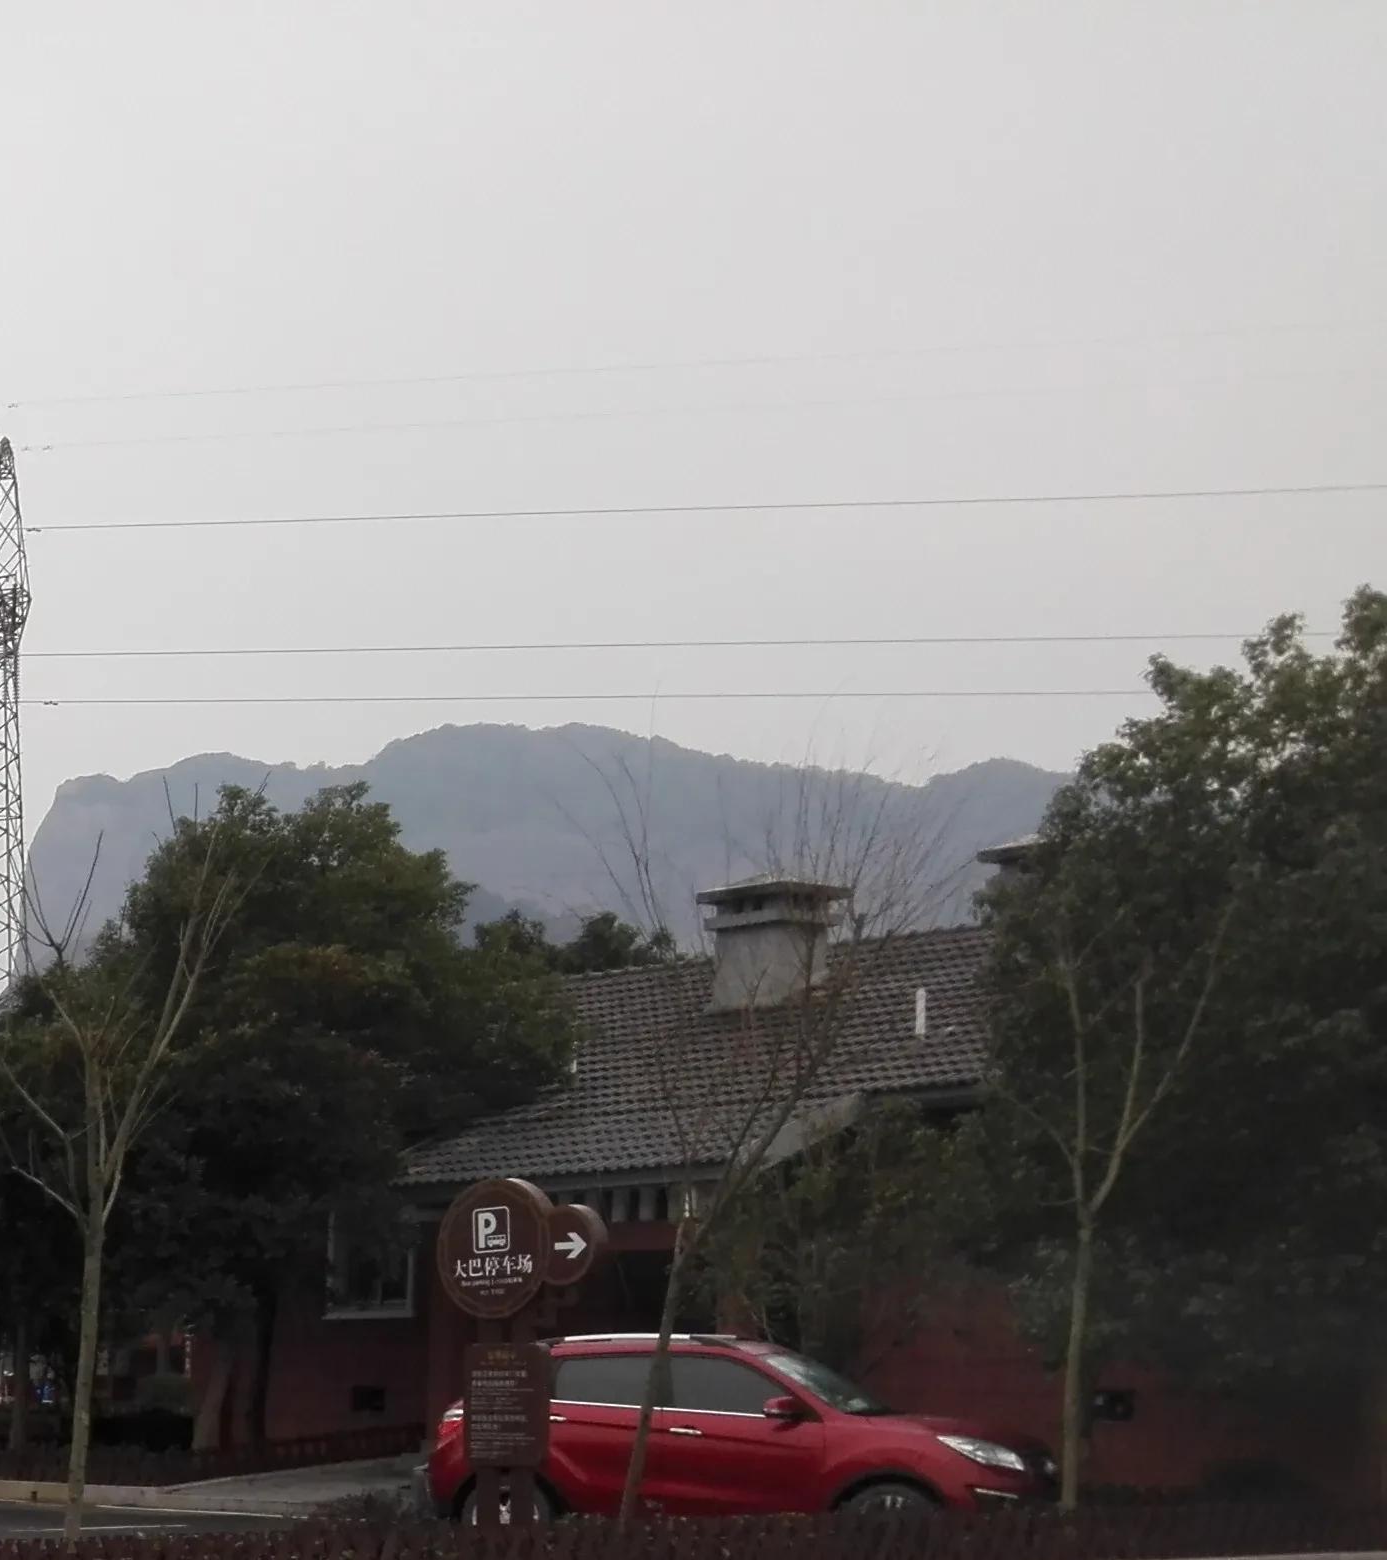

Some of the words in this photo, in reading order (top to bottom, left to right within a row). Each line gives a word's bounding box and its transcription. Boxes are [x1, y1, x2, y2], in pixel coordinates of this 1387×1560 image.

[478, 1212, 497, 1248] P
[454, 1254, 533, 1277] 大巴停车场
